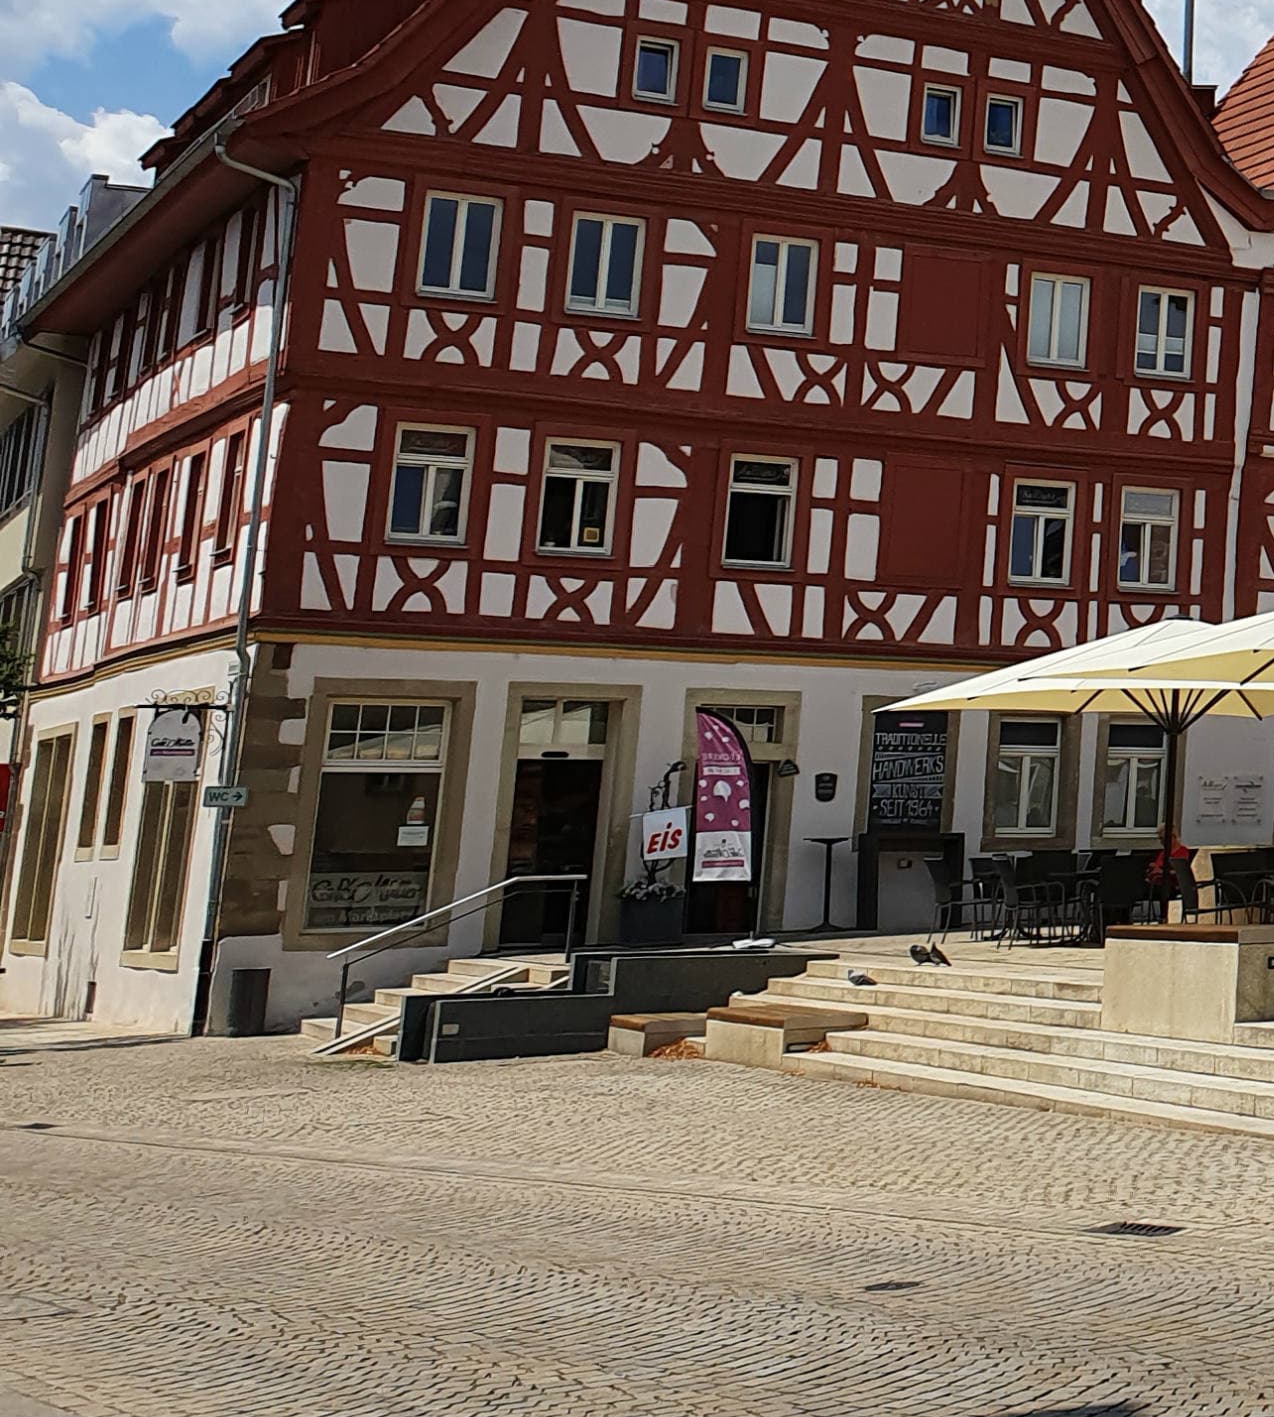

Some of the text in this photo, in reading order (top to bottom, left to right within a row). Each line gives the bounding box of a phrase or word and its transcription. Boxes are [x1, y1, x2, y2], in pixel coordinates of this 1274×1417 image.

[874, 733, 947, 746] TRADITIONELLE
[872, 754, 945, 781] HANDWERKS
[208, 791, 229, 802] WC
